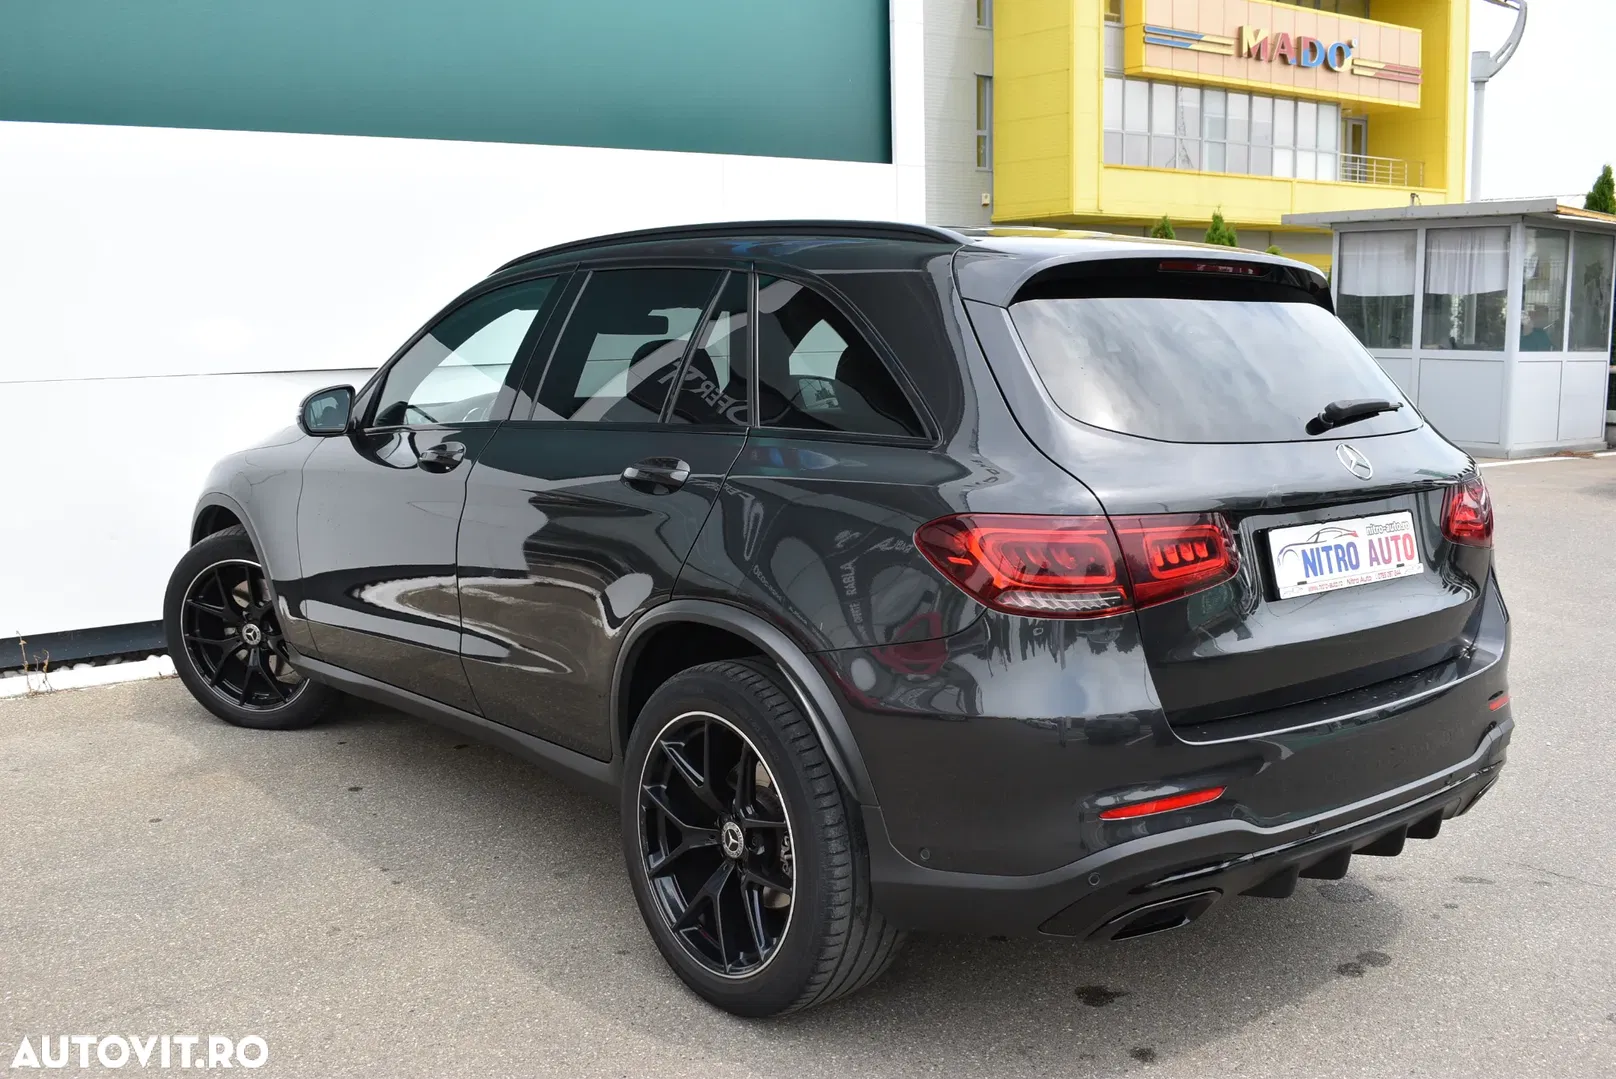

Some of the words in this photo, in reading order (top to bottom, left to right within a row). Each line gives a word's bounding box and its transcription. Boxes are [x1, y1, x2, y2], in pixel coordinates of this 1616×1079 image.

[1365, 520, 1410, 536] nitro-auto.ro
[1301, 541, 1360, 578] NITRO
[1368, 533, 1415, 567] AUTO
